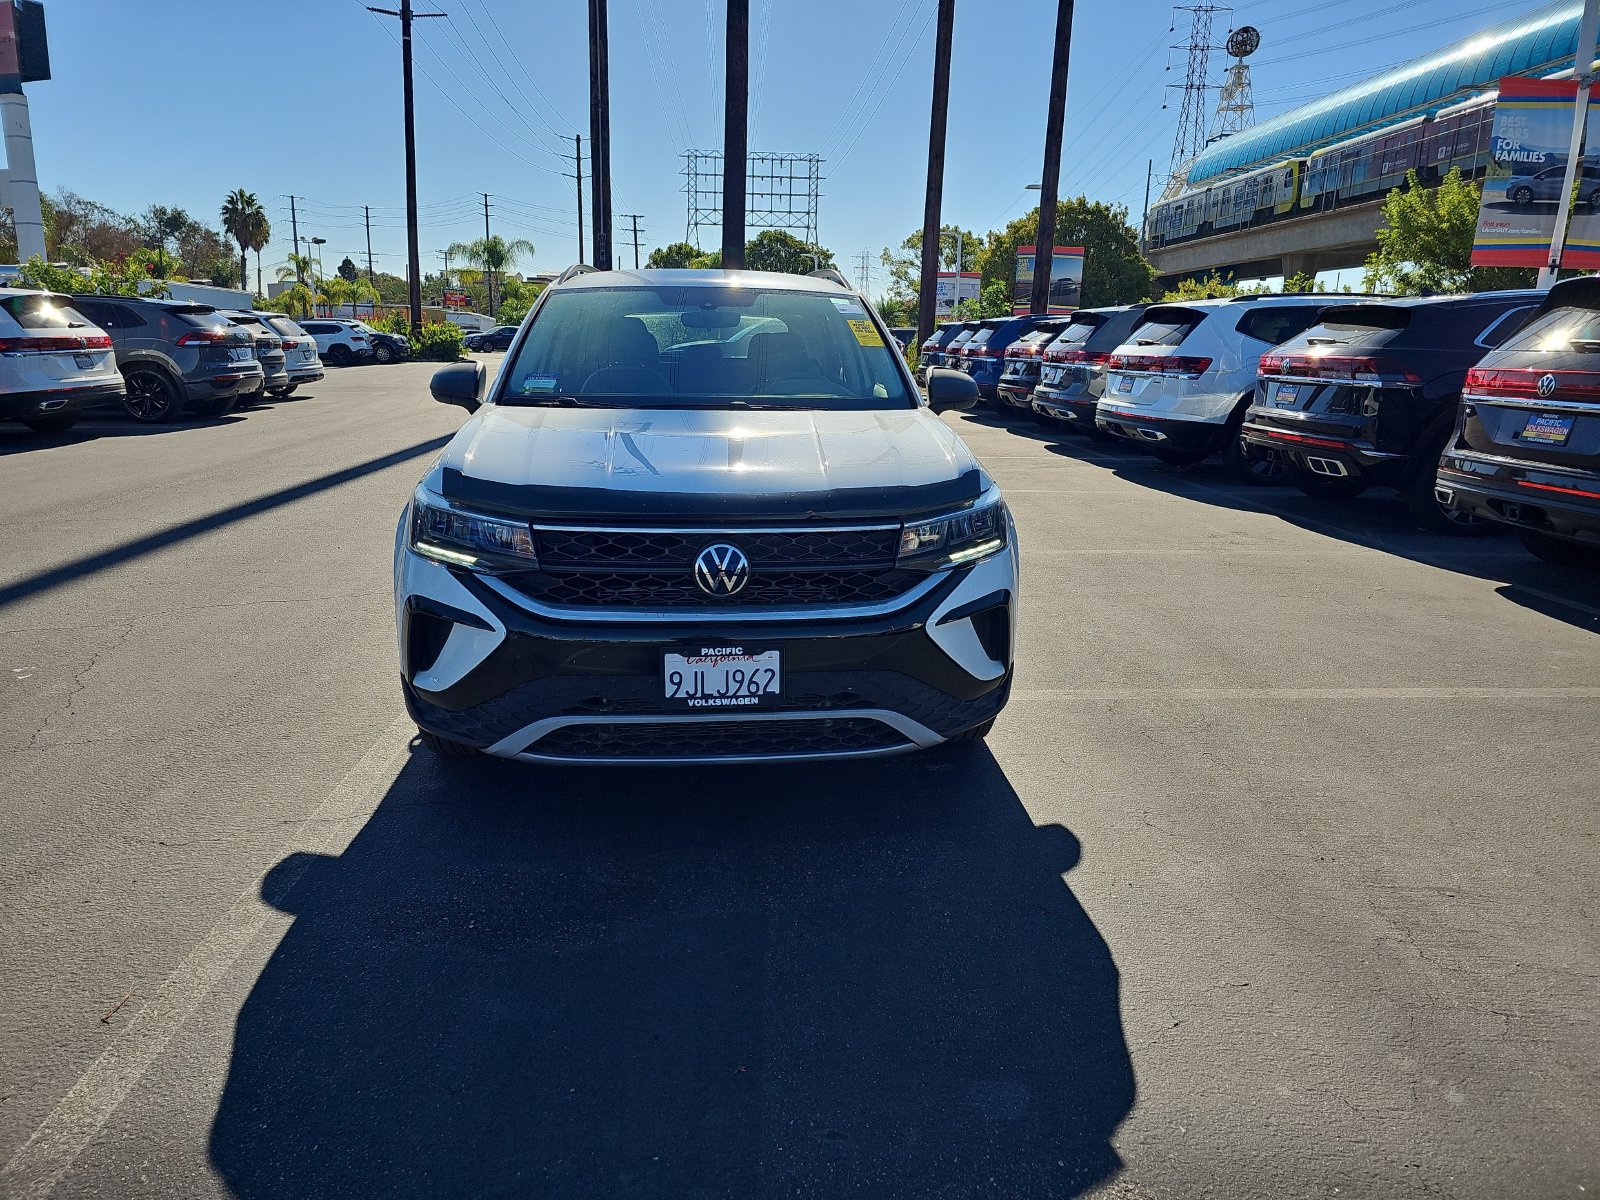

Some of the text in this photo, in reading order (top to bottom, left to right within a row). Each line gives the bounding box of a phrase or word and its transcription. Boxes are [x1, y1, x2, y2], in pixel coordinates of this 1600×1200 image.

[1501, 116, 1527, 128] BEST
[1500, 127, 1529, 140] CARS
[1497, 139, 1520, 150] FOR
[1494, 150, 1546, 163] FAMILIES
[1536, 418, 1562, 427] PACIFIC
[1526, 425, 1568, 435] VOLKSWAGEN
[701, 647, 744, 656] PACIFIC
[669, 668, 776, 698] 9JLJ962
[687, 697, 759, 707] VOLKSWAGEN
